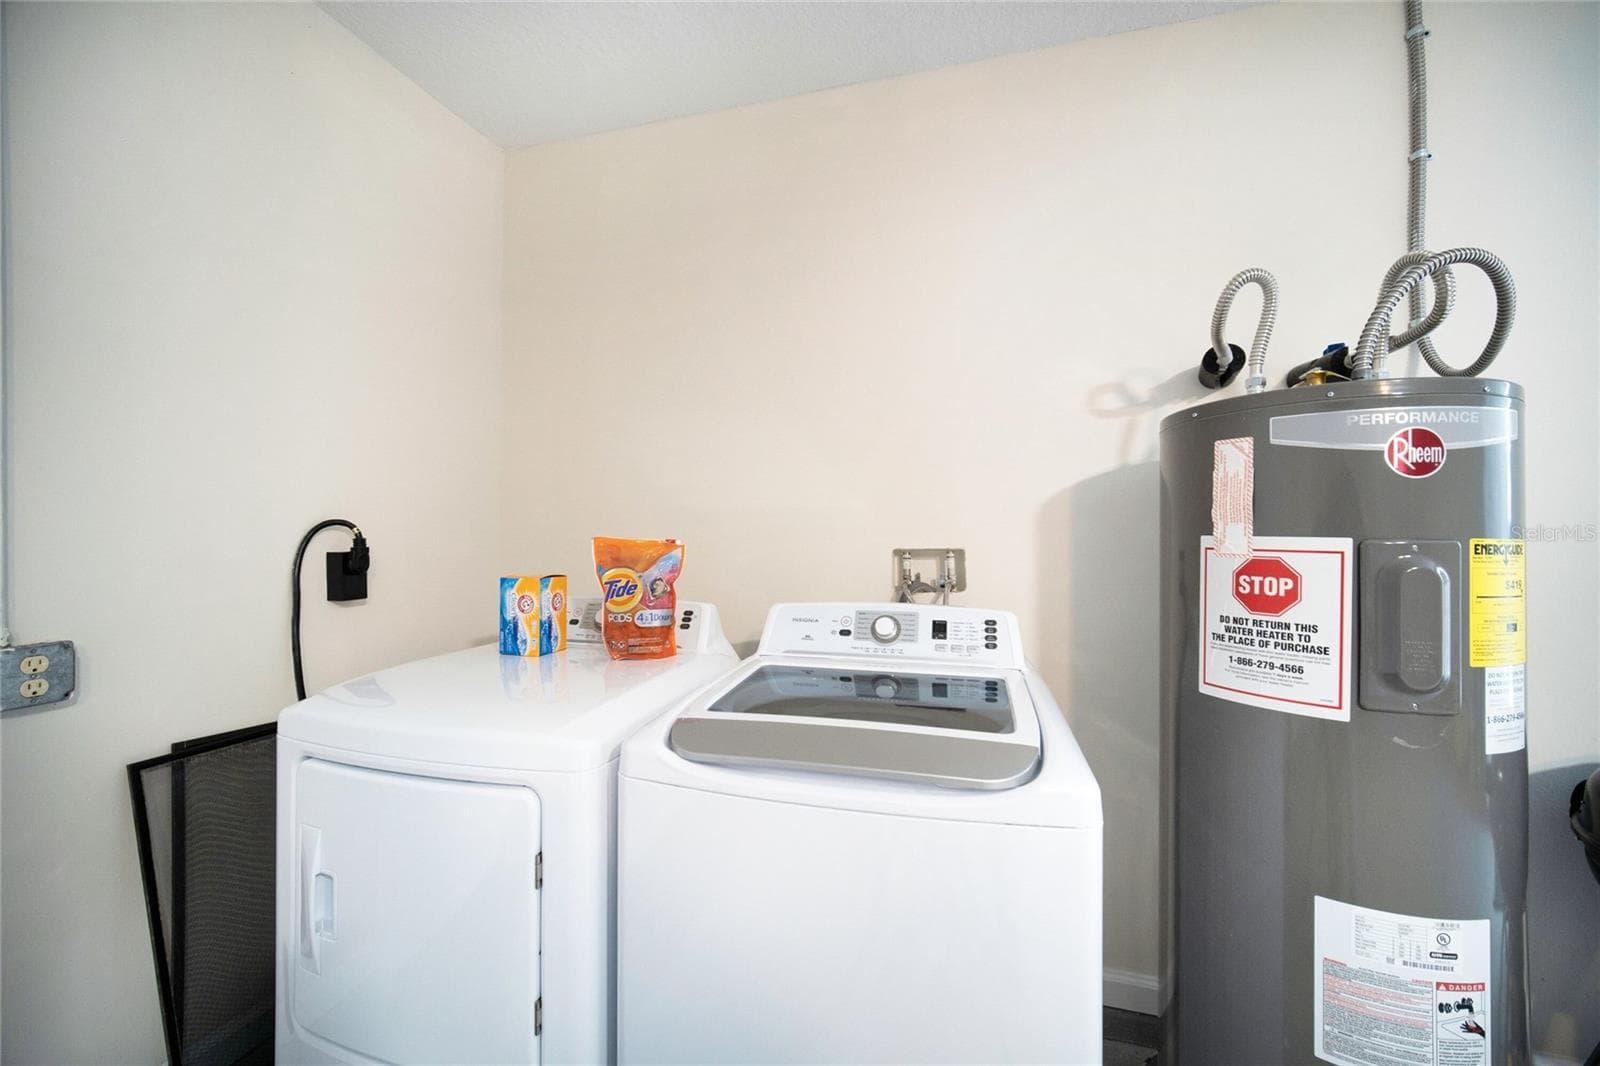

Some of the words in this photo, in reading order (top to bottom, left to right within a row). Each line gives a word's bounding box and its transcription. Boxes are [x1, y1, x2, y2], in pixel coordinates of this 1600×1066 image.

[1347, 411, 1479, 426] PERFORMANCE
[1393, 428, 1442, 470] Rheem
[604, 579, 638, 603] Tide
[1238, 575, 1294, 597] STOP
[608, 613, 633, 623] PODS
[1219, 614, 1231, 624] DO
[1232, 616, 1250, 627] NOT
[1252, 618, 1291, 631] RETURN
[1294, 622, 1319, 634] THIS
[1211, 632, 1226, 643] THE
[1228, 634, 1256, 647] PLACE
[1258, 638, 1272, 649] OF
[1273, 641, 1330, 656] PURCHASE
[1224, 625, 1254, 637] WATER
[1256, 628, 1294, 641] HEATER
[1296, 633, 1311, 644] TO
[1228, 655, 1305, 675] 1-866-279-4566
[1449, 983, 1483, 992] DANGER
